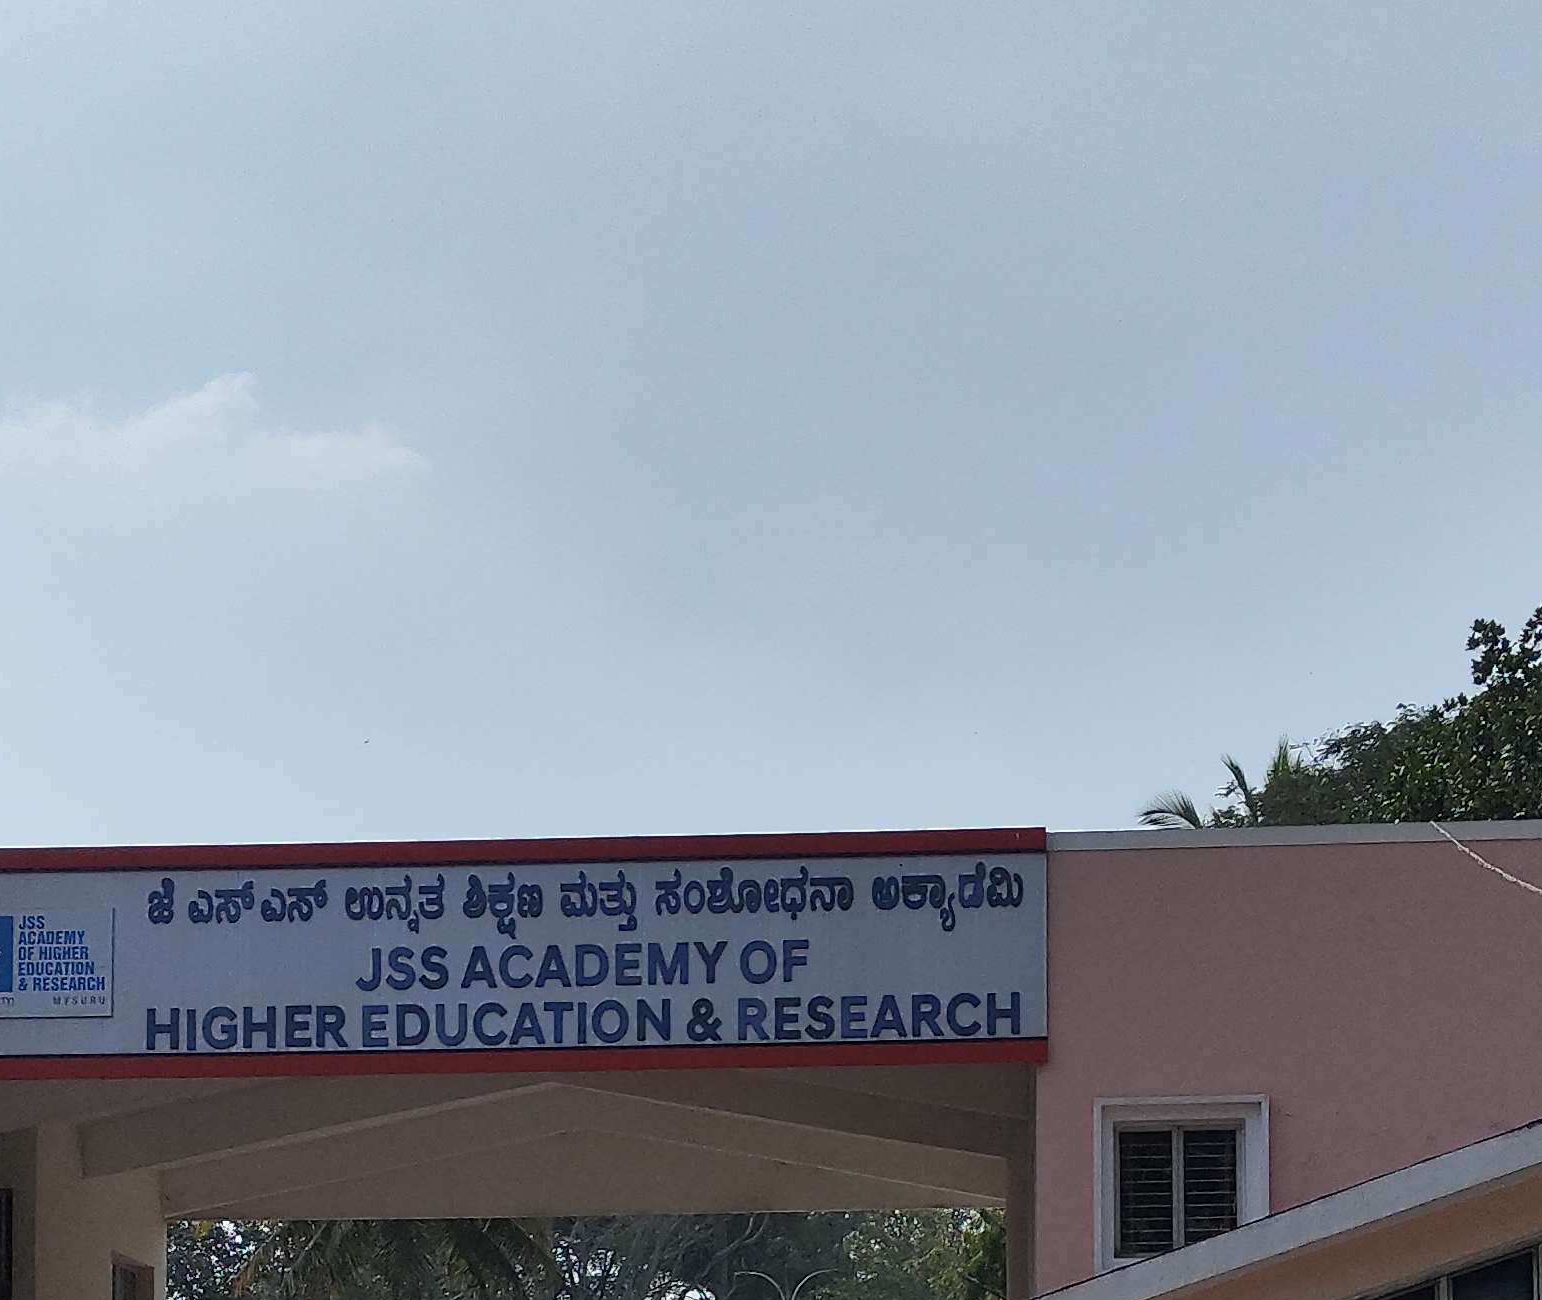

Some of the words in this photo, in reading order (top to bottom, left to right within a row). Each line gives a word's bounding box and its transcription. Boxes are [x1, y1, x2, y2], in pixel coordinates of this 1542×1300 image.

[147, 877, 175, 924] ಜೆ
[344, 872, 446, 933] ಉನ್ನತ
[462, 871, 544, 940] ಶಿಕ್ಷಣ
[559, 869, 638, 932] ಮತ್ತು
[654, 865, 855, 921] ಸಂಶೋಧನಾ
[871, 860, 1025, 933] ಅಕ್ಯಾಡೆಮಿ
[19, 915, 45, 930] JSS
[18, 930, 85, 945] ACADEMY
[18, 946, 35, 960] OF
[39, 946, 89, 960] HIGHER
[18, 961, 95, 976] EDUCATION
[356, 944, 450, 992] JSS
[460, 940, 729, 990] ACADEMY
[739, 939, 809, 985] OF
[18, 977, 28, 991] &
[32, 976, 106, 991] RESEARCH
[145, 1004, 349, 1051] HIGHER
[361, 998, 671, 1048] EDUCATION
[686, 998, 723, 1043] &
[737, 991, 1021, 1042] RESEARCH
